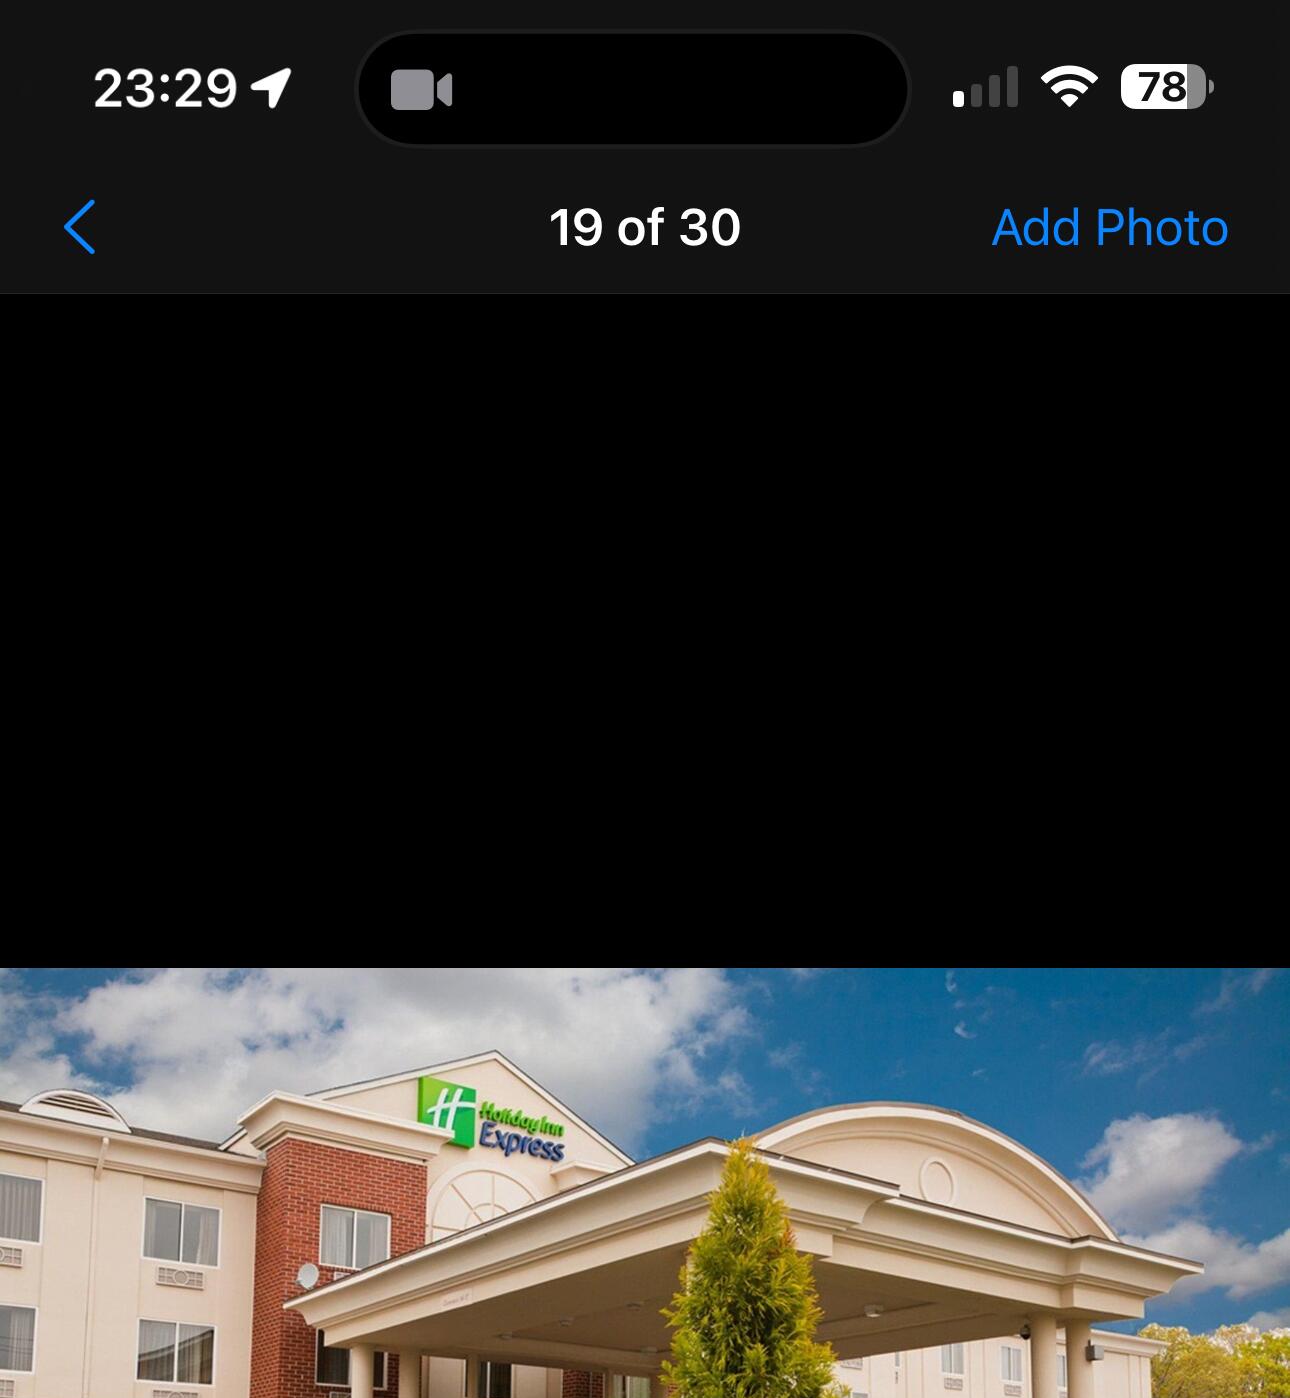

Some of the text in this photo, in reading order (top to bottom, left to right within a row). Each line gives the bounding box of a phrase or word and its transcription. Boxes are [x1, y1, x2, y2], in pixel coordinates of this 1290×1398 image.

[479, 1101, 564, 1137] Holiday Inn
[479, 1120, 564, 1162] Express
